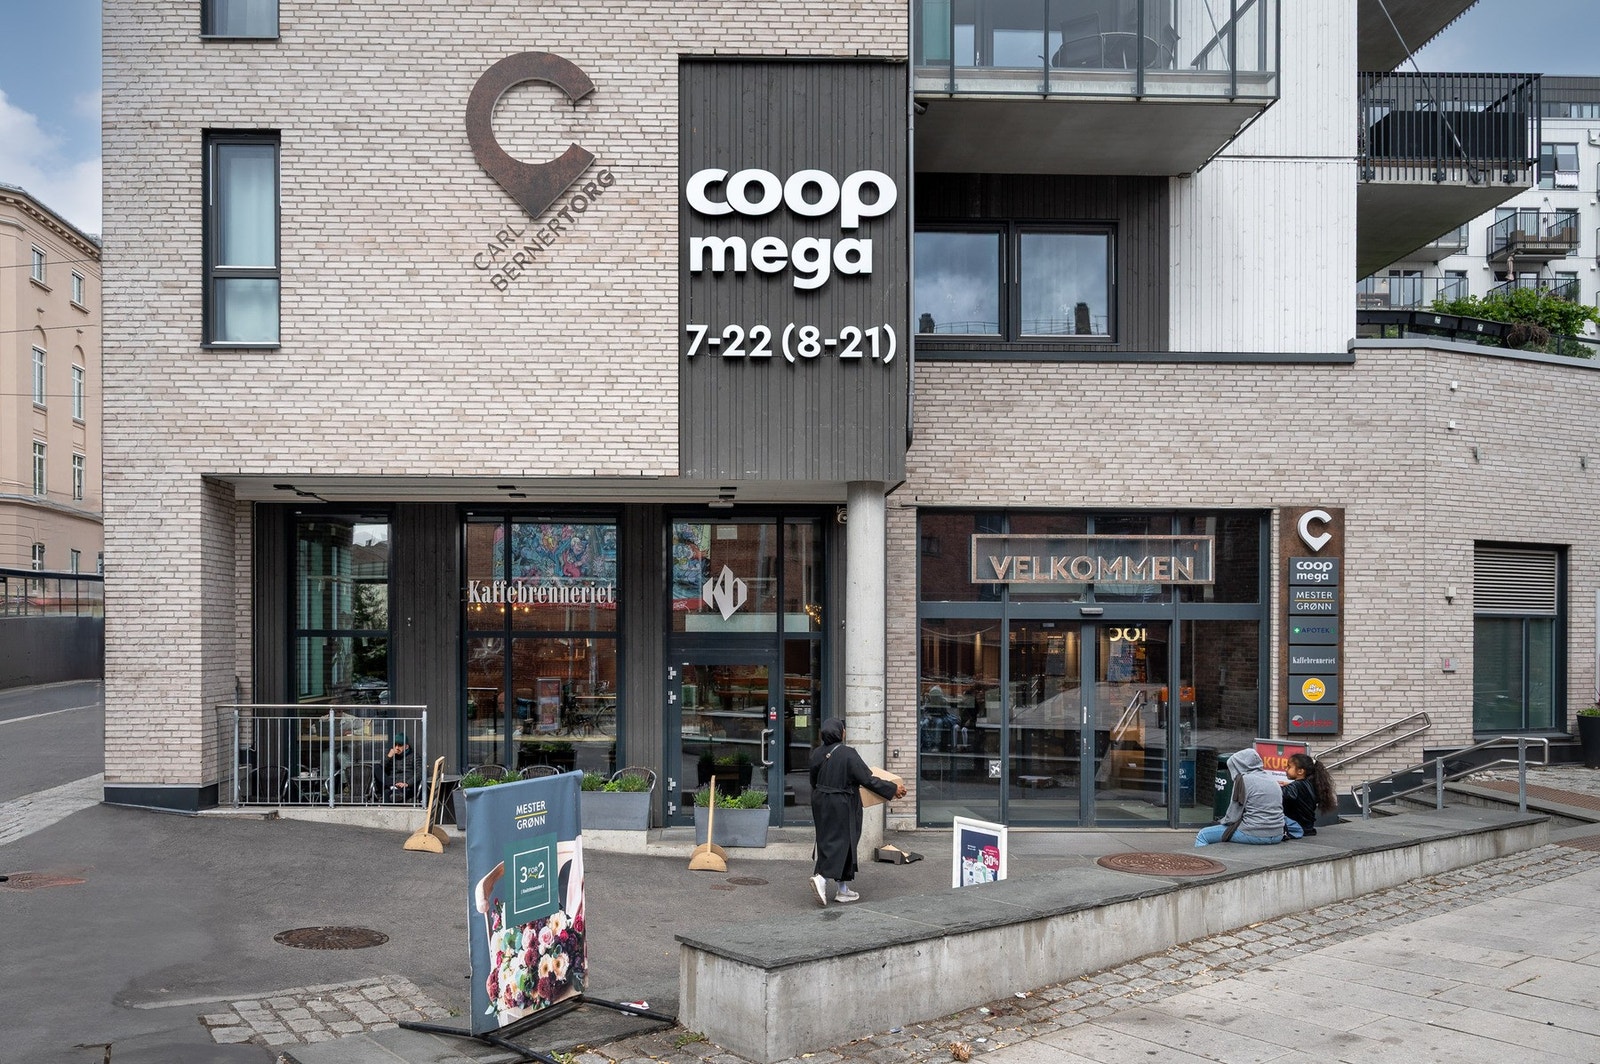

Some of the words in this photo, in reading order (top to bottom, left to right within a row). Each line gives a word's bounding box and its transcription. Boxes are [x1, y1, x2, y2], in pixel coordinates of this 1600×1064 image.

[685, 168, 898, 231] coop
[473, 224, 525, 271] CARL
[689, 235, 874, 290] mega
[685, 324, 773, 358] 7-22
[781, 322, 897, 364] (8-21)
[988, 555, 1195, 581] VELKOMMEN
[1296, 561, 1333, 572] coop
[1296, 572, 1329, 583] mega
[467, 579, 615, 604] Kaffebrenneriet
[1296, 591, 1333, 599] MESTER
[1296, 602, 1332, 610] GRØNN
[1263, 756, 1289, 770] KUP
[515, 800, 546, 816] MESTER
[516, 815, 546, 830] GRØNN
[984, 855, 999, 867] 30%
[520, 866, 528, 883] 3
[537, 861, 545, 879] 2
